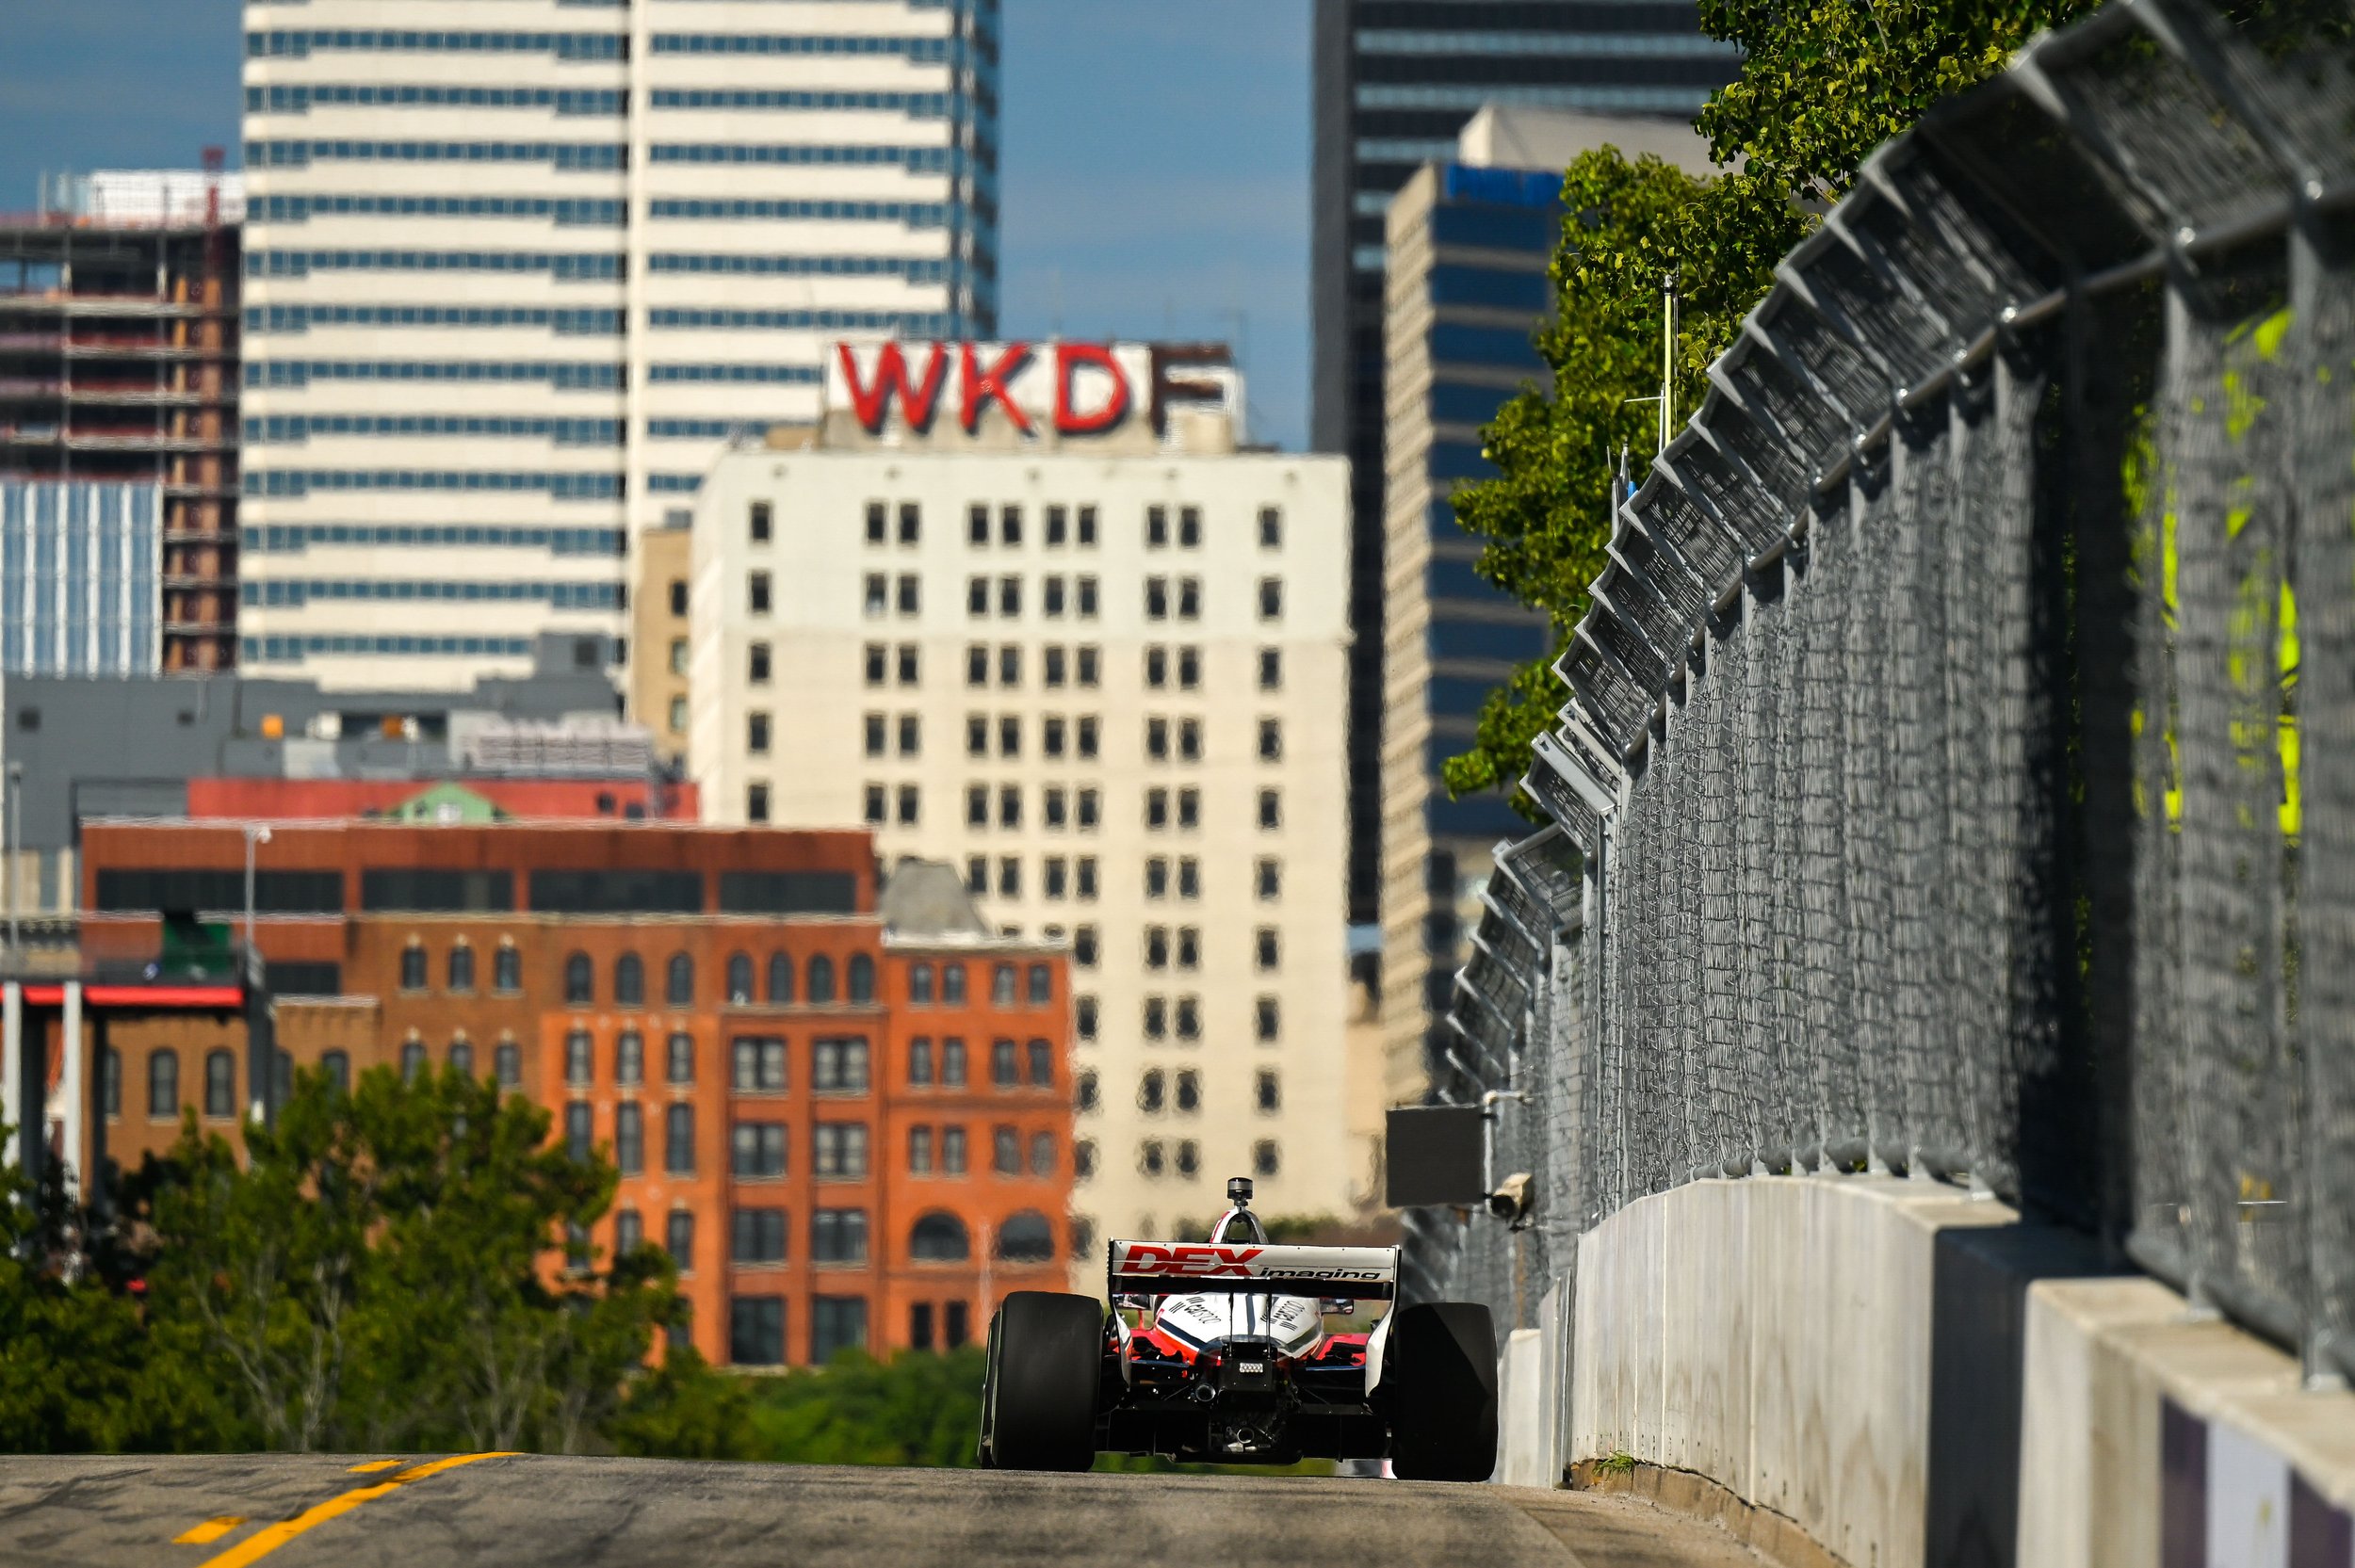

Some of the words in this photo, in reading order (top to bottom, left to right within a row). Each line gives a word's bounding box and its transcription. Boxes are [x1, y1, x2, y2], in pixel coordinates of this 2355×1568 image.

[837, 342, 1230, 436] WKDF
[1120, 1245, 1264, 1276] DEX
[1259, 1267, 1380, 1280] imaging
